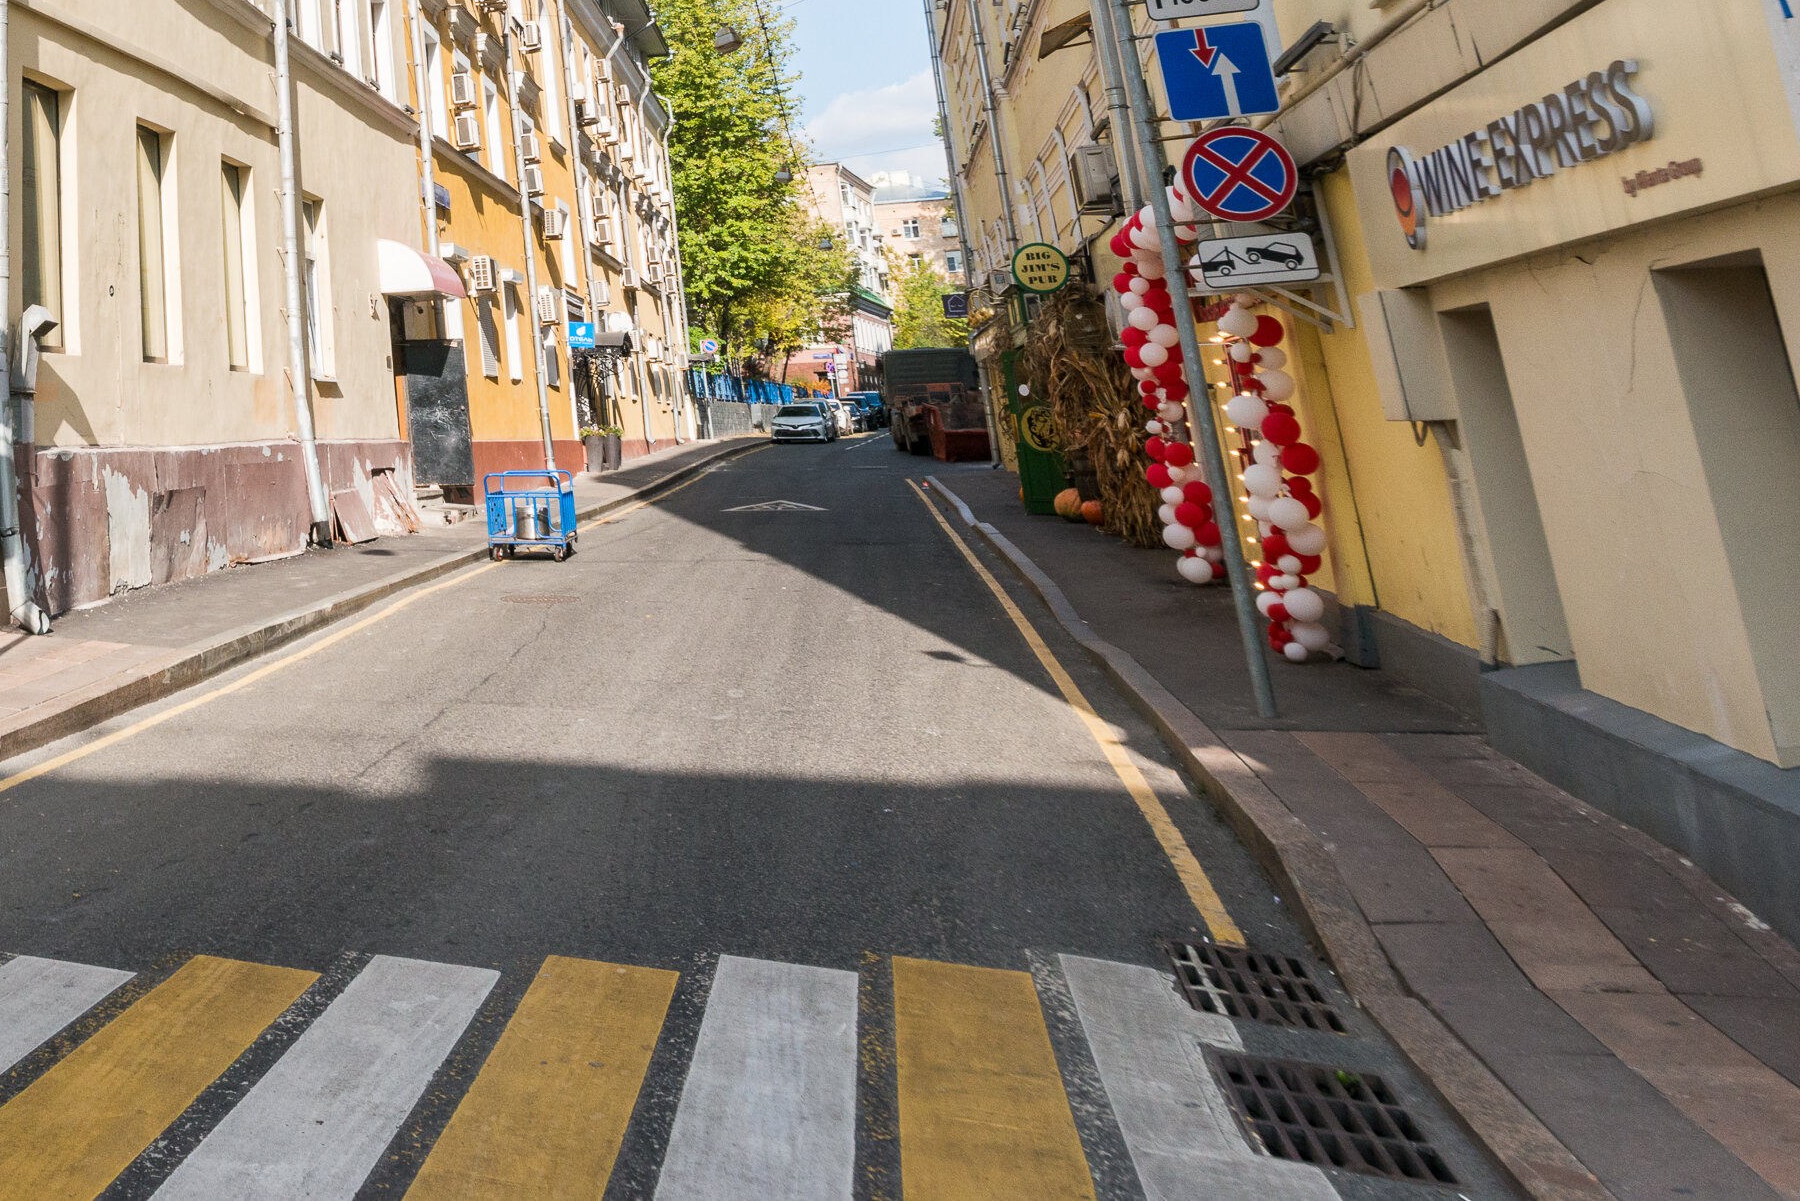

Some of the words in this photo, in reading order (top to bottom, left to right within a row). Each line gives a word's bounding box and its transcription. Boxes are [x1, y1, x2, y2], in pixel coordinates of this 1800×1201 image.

[1025, 251, 1051, 261] BIG
[1021, 262, 1060, 273] JIM'S
[1028, 275, 1058, 285] PUB
